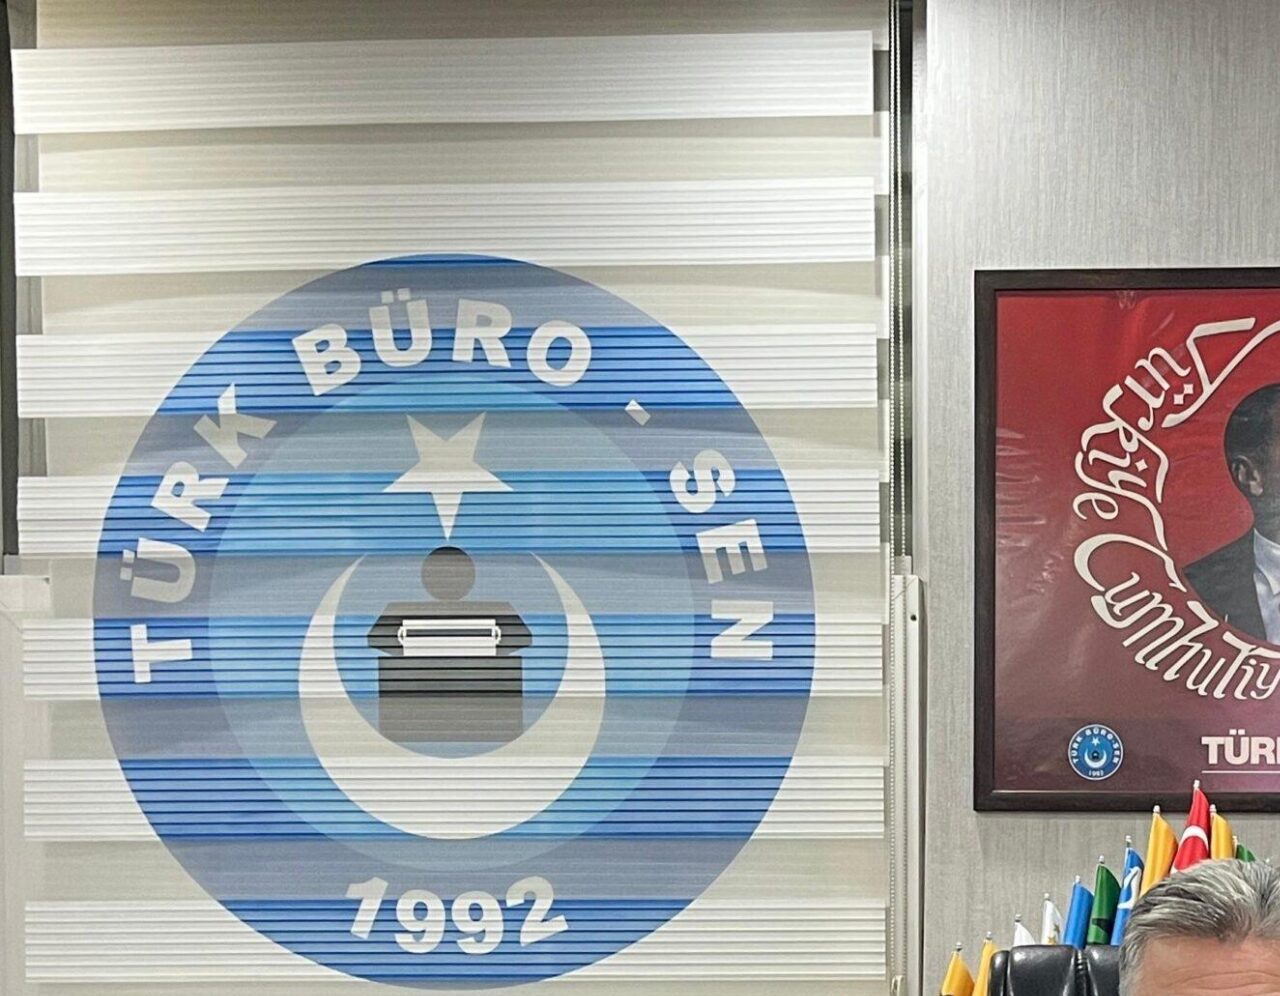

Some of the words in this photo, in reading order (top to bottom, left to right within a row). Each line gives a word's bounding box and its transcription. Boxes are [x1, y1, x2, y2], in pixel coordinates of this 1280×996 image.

[119, 382, 278, 684] TÜRK
[291, 288, 593, 397] BÜRO
[344, 876, 569, 955] 1992
